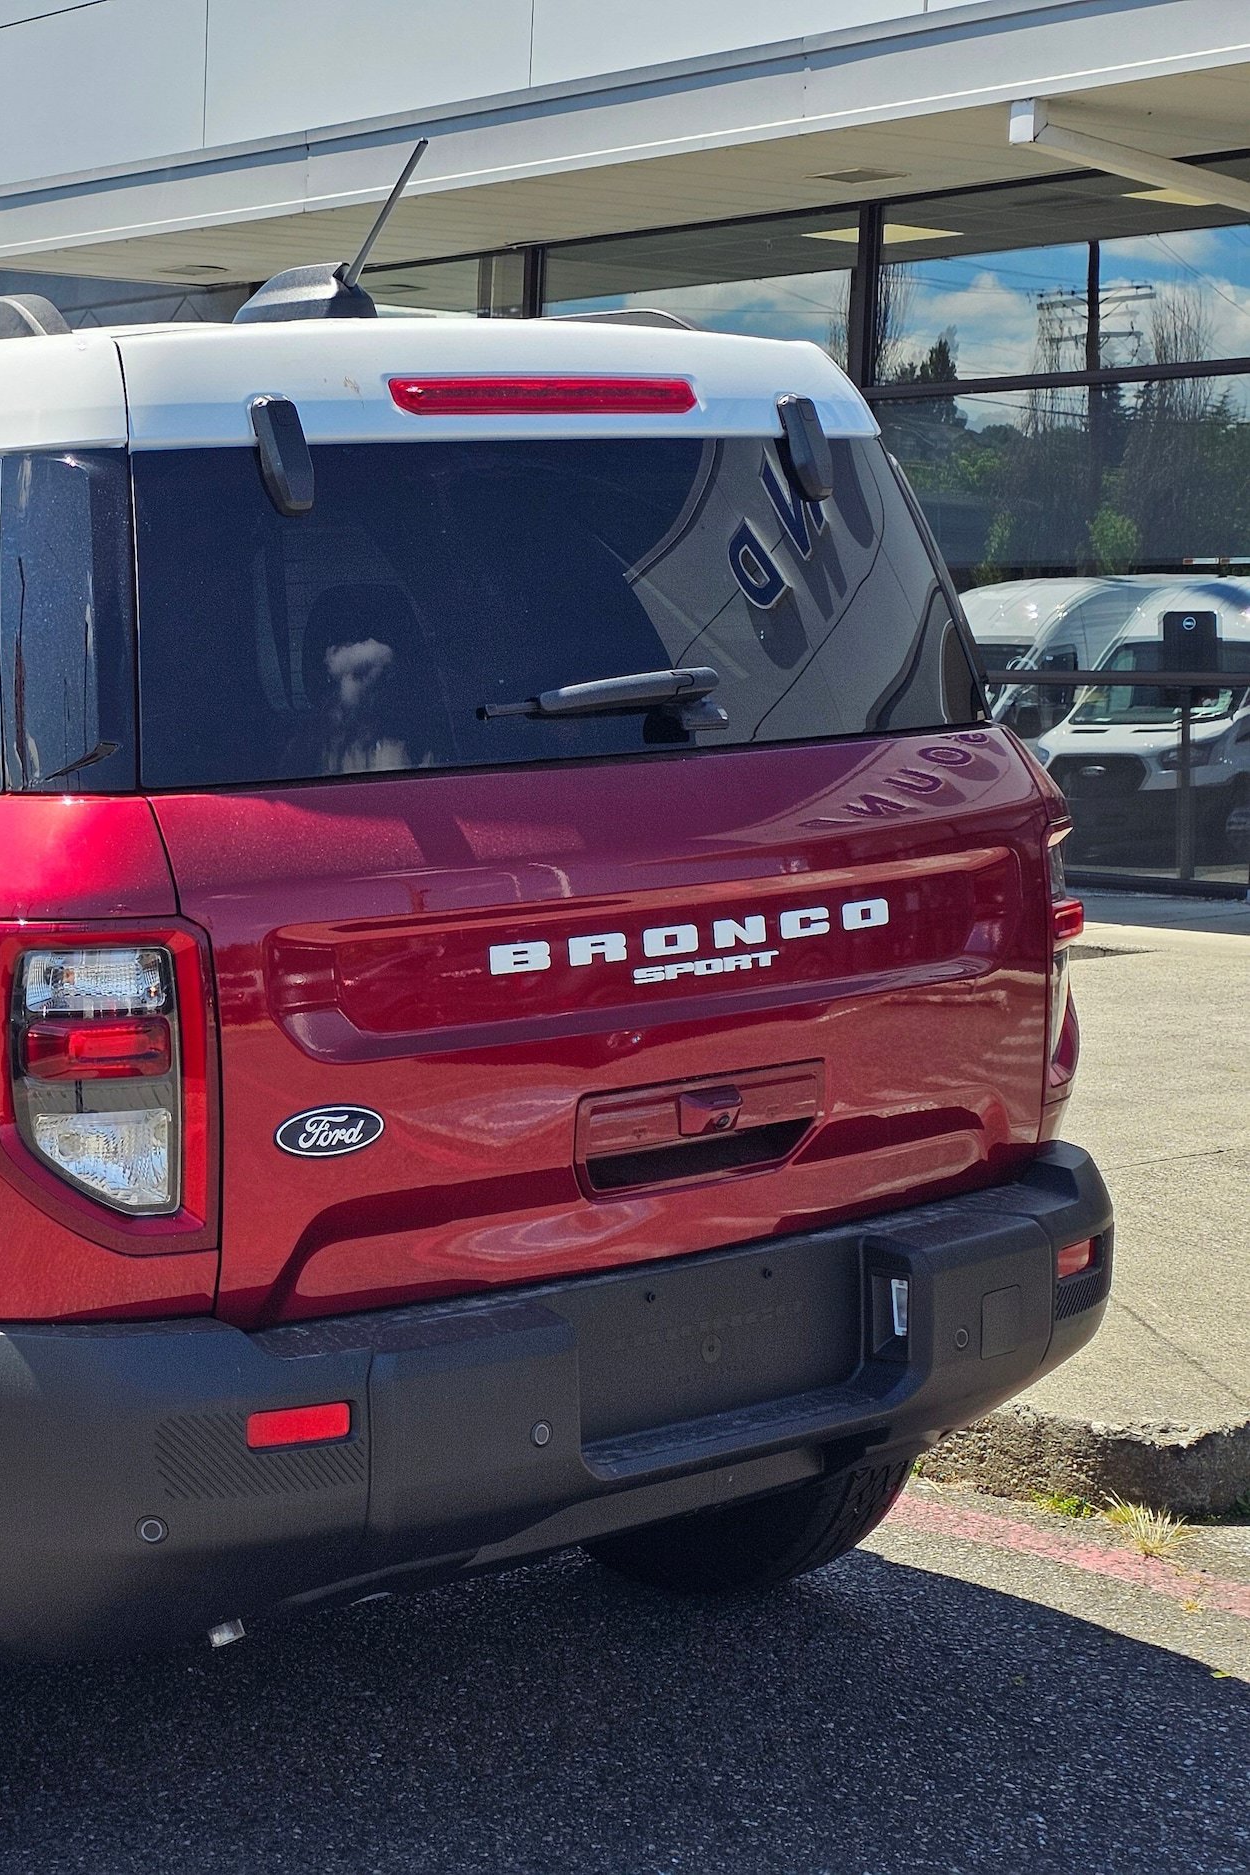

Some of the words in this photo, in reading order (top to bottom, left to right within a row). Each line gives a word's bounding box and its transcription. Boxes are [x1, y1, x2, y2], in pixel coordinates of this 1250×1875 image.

[489, 898, 890, 976] BRONCO
[633, 949, 780, 985] SPORT
[298, 1114, 365, 1149] Ford
